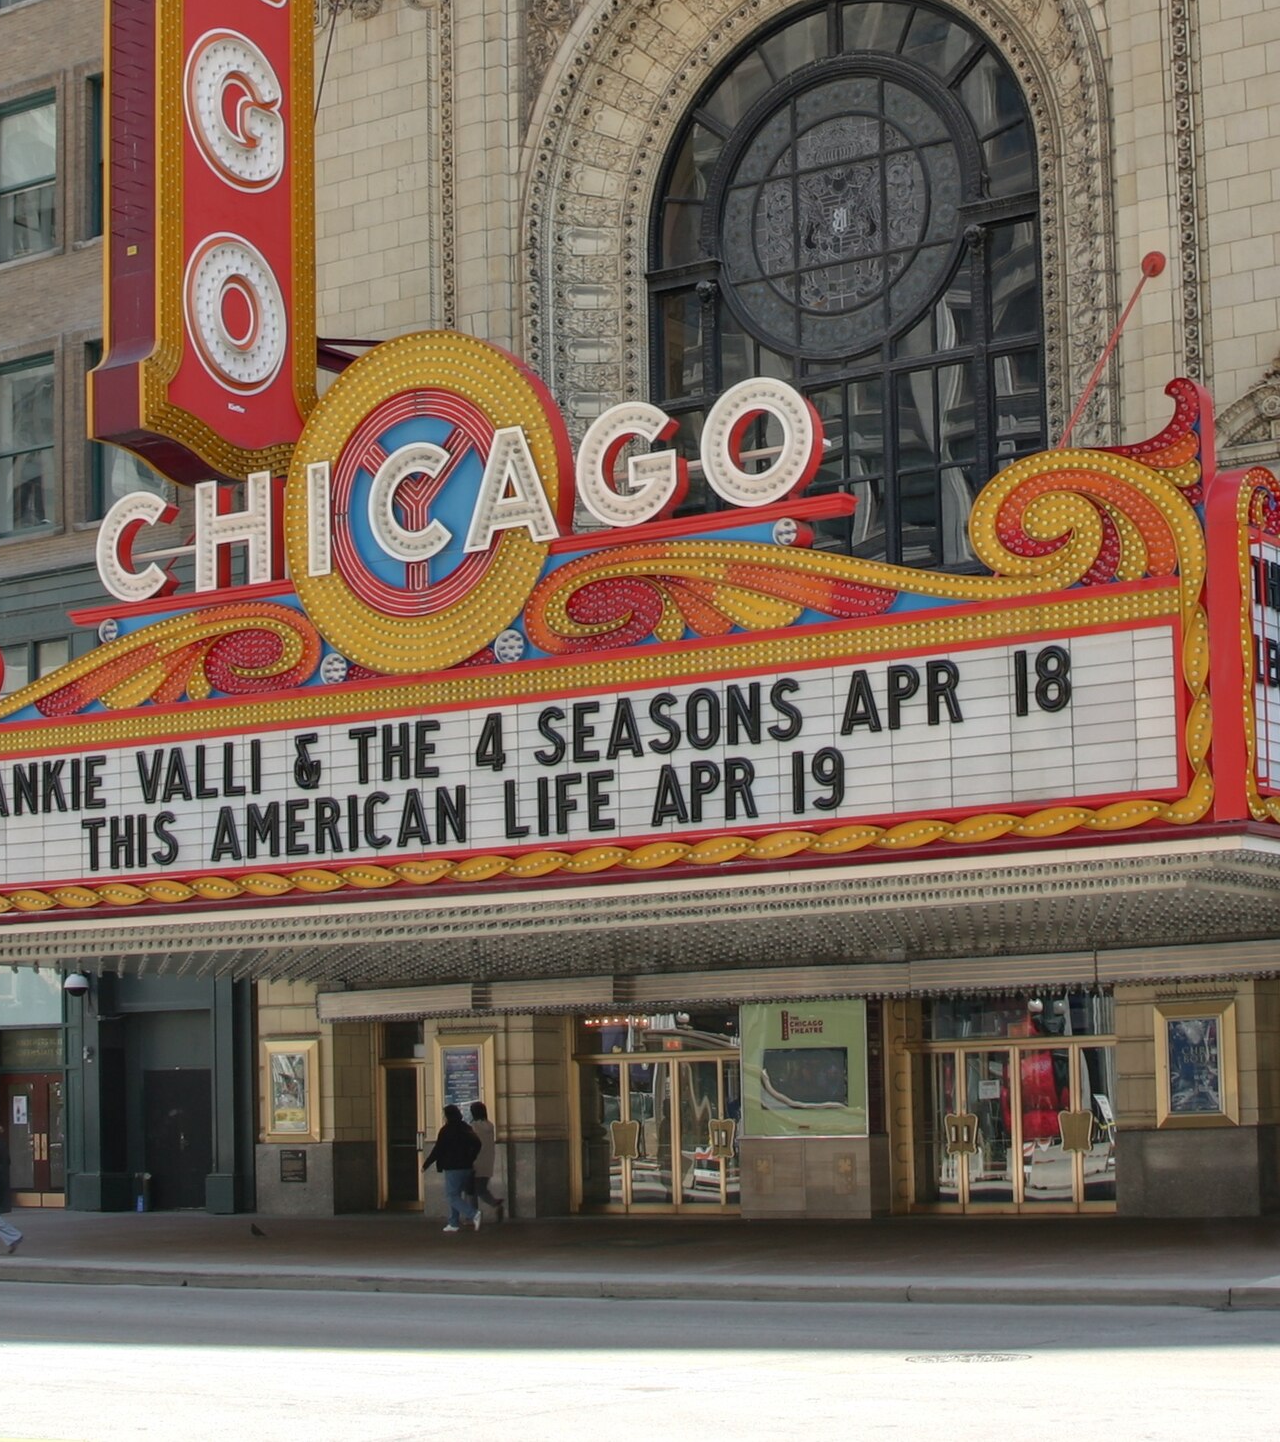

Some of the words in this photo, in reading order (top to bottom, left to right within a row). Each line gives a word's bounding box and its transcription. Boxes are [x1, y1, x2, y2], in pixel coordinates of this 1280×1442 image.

[95, 376, 815, 603] CHICAGO
[137, 738, 262, 803] VALLI
[293, 732, 322, 790] &
[349, 719, 441, 785] THE
[476, 712, 507, 772] 4
[534, 677, 803, 767] SEASONS
[841, 659, 964, 736] APR
[1014, 645, 1072, 718] 18
[81, 810, 180, 872] THIS
[211, 784, 468, 863] AMERICAN
[505, 769, 616, 839] LIFE
[651, 756, 759, 827] APR
[792, 746, 846, 815] 19
